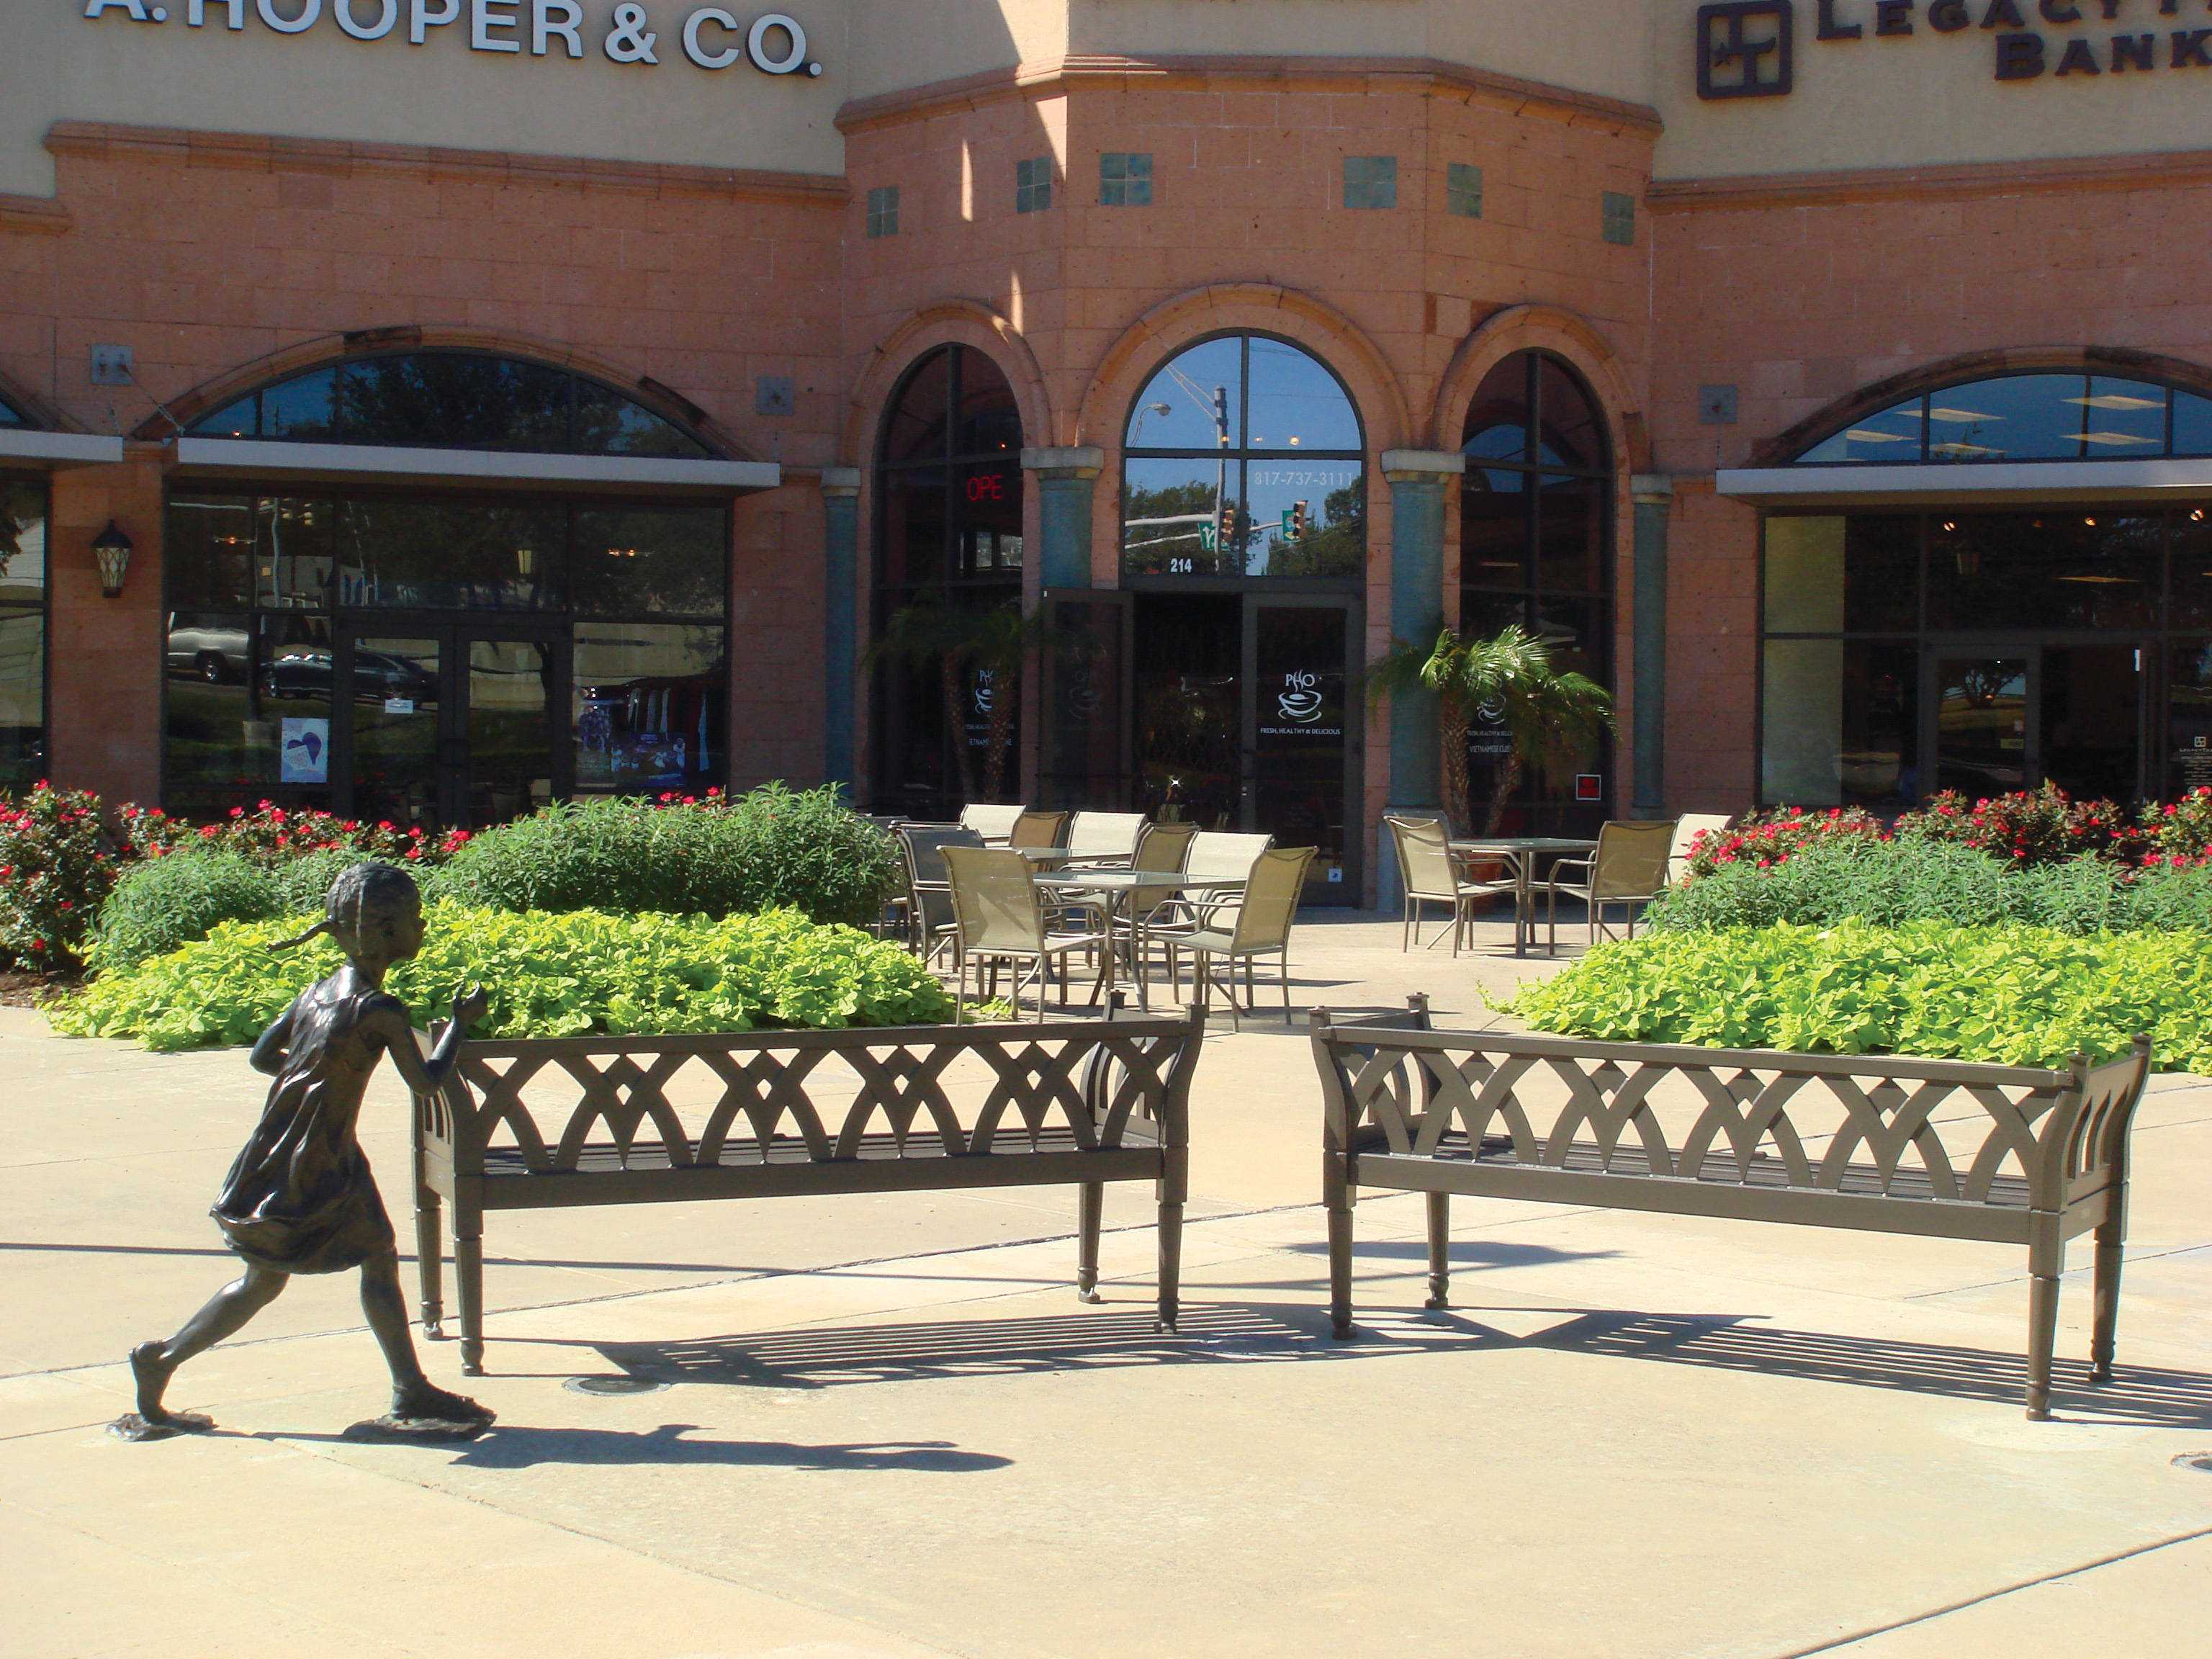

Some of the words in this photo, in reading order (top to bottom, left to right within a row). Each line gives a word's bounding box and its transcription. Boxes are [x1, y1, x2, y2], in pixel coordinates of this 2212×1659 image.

[603, 1, 660, 65] &
[681, 6, 822, 76] CO.
[1994, 29, 2212, 81] BANK
[1254, 472, 1352, 486] 817-737-3111
[1170, 557, 1192, 573] 214
[1285, 669, 1316, 692] PHO
